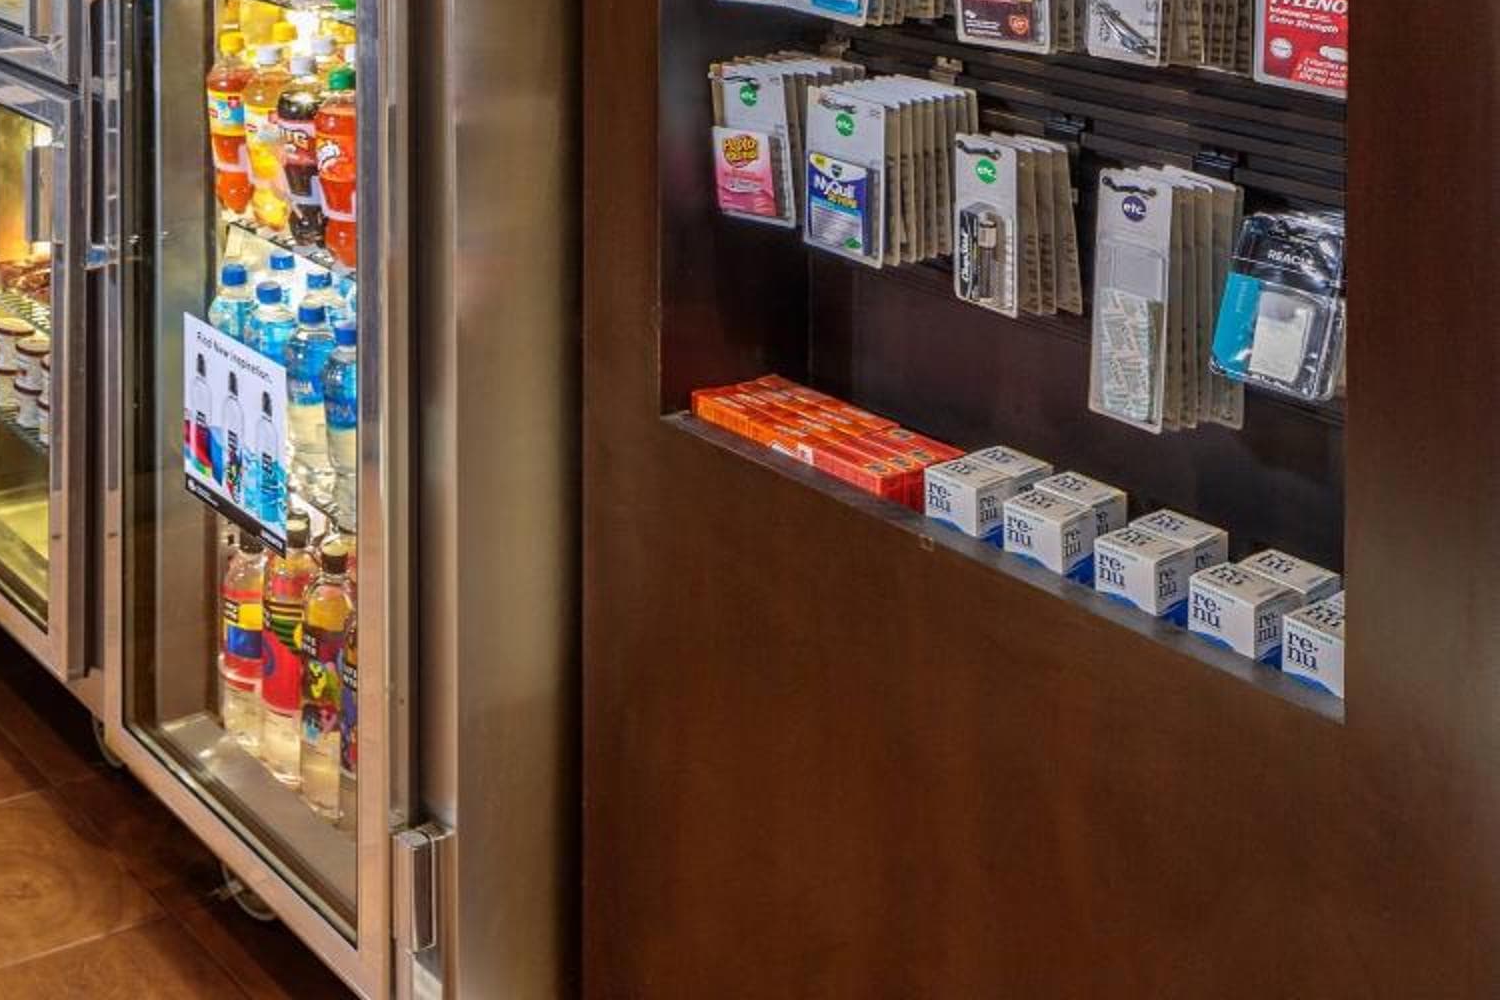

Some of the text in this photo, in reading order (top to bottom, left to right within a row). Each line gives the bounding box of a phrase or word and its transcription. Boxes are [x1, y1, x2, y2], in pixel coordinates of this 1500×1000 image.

[1268, 14, 1295, 25] Extra
[1296, 20, 1339, 34] Strength
[813, 174, 857, 197] NyQuil
[928, 493, 951, 513] nu
[1006, 528, 1032, 547] nu
[1098, 566, 1126, 587] nu
[1192, 606, 1221, 629] nu
[1285, 646, 1319, 671] nu
